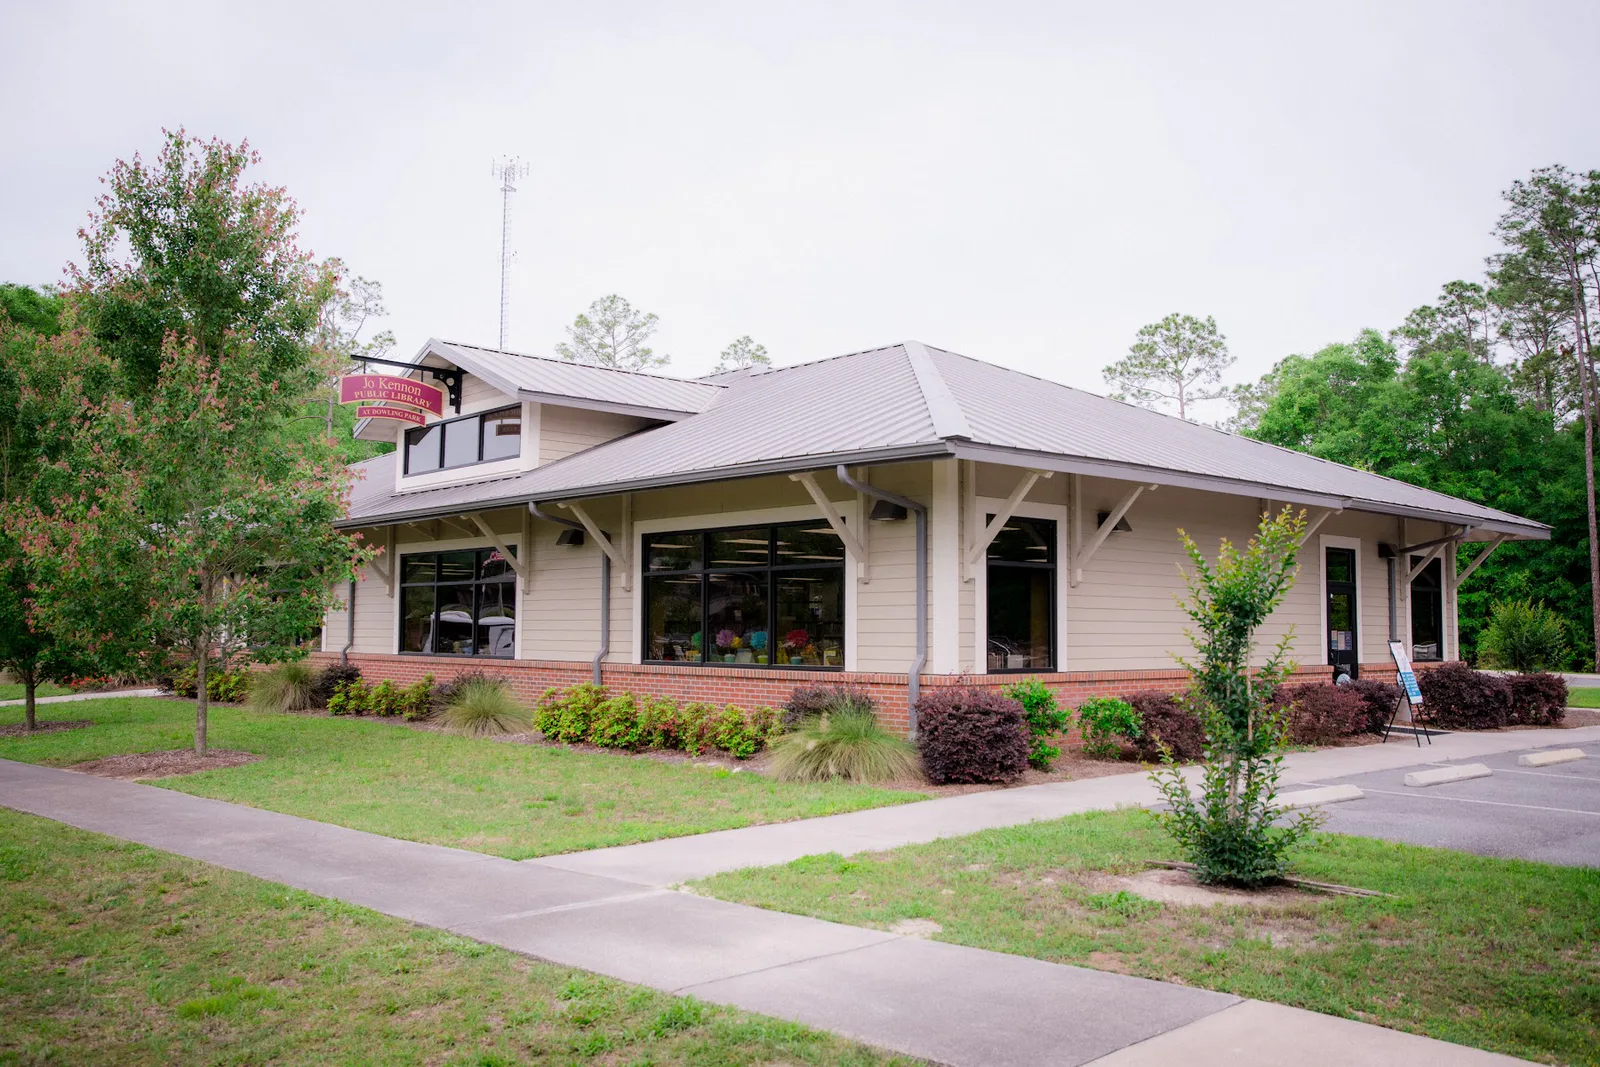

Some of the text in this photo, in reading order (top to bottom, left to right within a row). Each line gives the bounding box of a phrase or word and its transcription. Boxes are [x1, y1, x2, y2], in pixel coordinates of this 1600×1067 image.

[363, 377, 421, 396] Jo Kennon
[354, 390, 432, 408] PUBLIC LIBRARY
[372, 409, 404, 418] DOWLING
[404, 413, 422, 422] PARK
